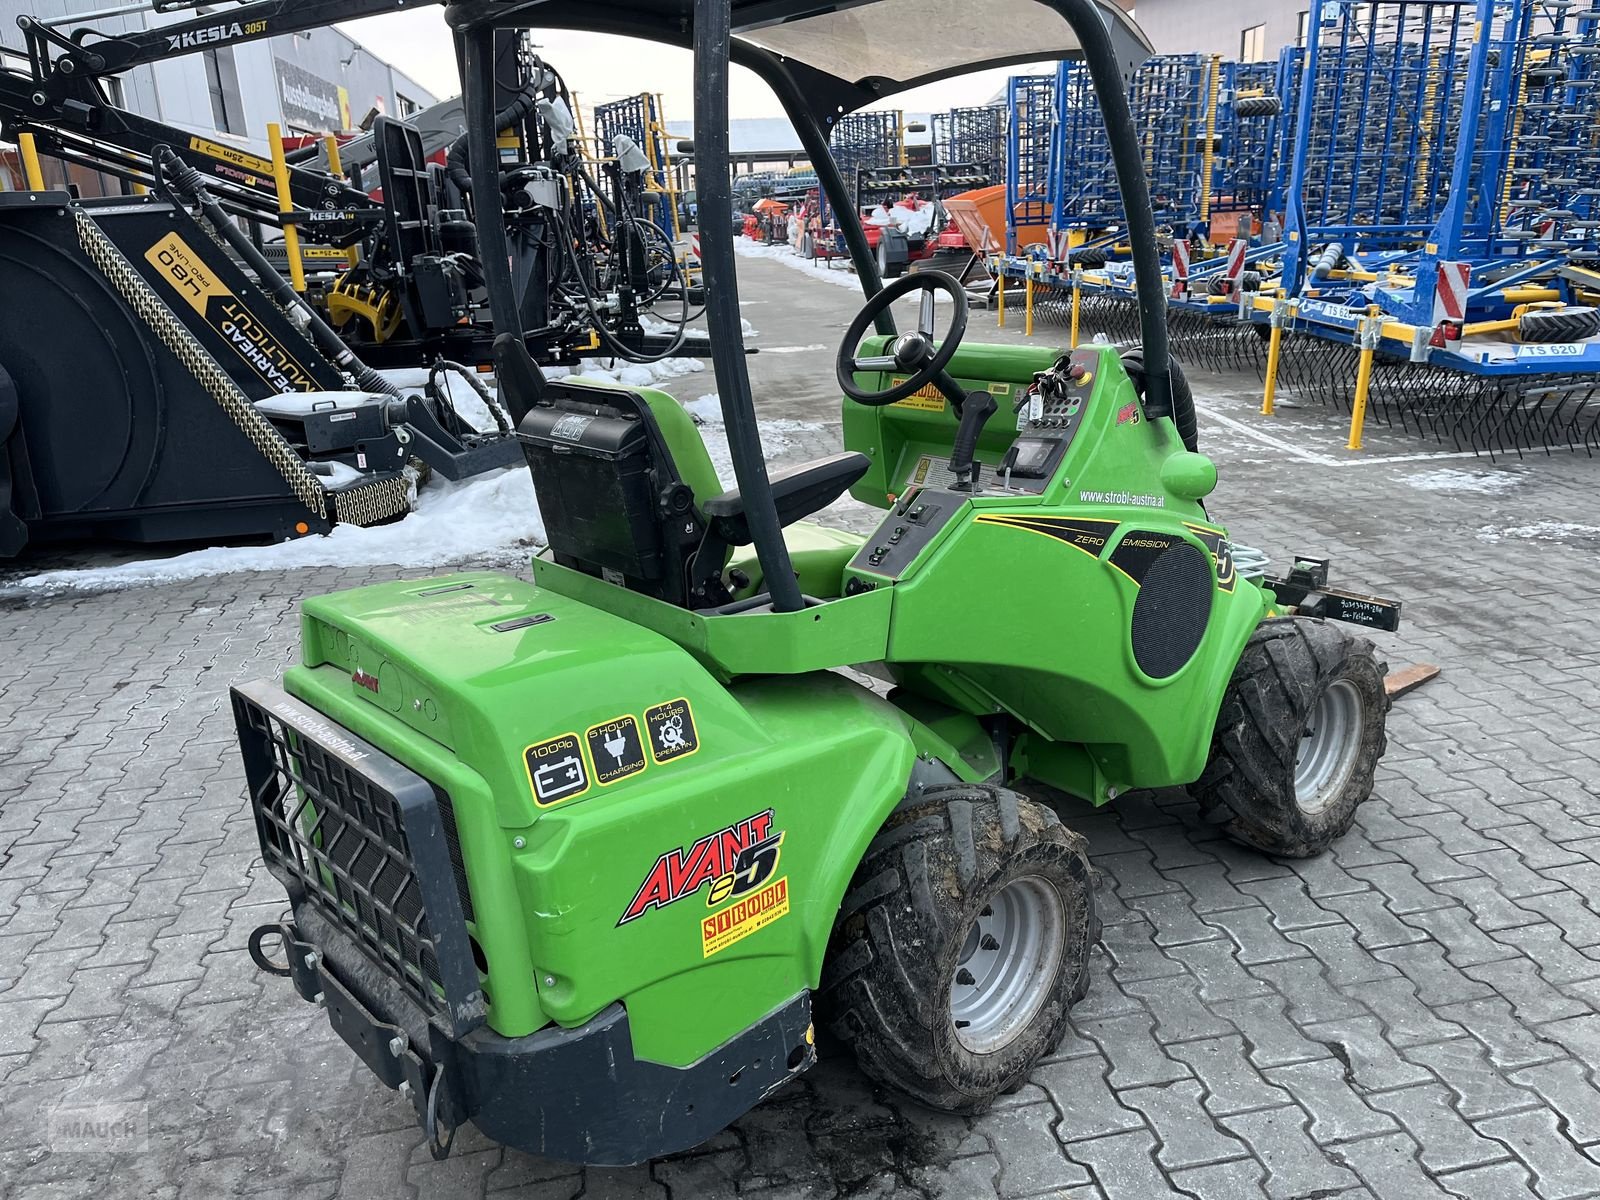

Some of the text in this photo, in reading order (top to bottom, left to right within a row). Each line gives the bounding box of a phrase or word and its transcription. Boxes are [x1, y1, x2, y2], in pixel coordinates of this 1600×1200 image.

[181, 20, 268, 48] KESLA 305T
[223, 149, 245, 164] 25m
[309, 211, 345, 221] KESLA
[157, 250, 202, 297] 480
[169, 243, 211, 288] PRO-LINE
[1328, 305, 1338, 316] TS
[222, 304, 316, 392] MULTICUT
[222, 320, 298, 394] PEARHEAD
[1525, 345, 1577, 355] TS 620
[1079, 490, 1165, 507] www.strobl-austria.at
[1074, 534, 1170, 549] ZERO EMISSION
[650, 706, 685, 723] HOURS
[273, 702, 371, 761] www.strobl-austria.at
[588, 718, 633, 739] 5 HOUR
[531, 740, 574, 759] 100%
[655, 741, 693, 759] OPERATIN
[600, 759, 645, 781] CHARGING
[614, 807, 774, 929] AVANT
[706, 830, 786, 908] e5
[703, 879, 786, 941] STROBL
